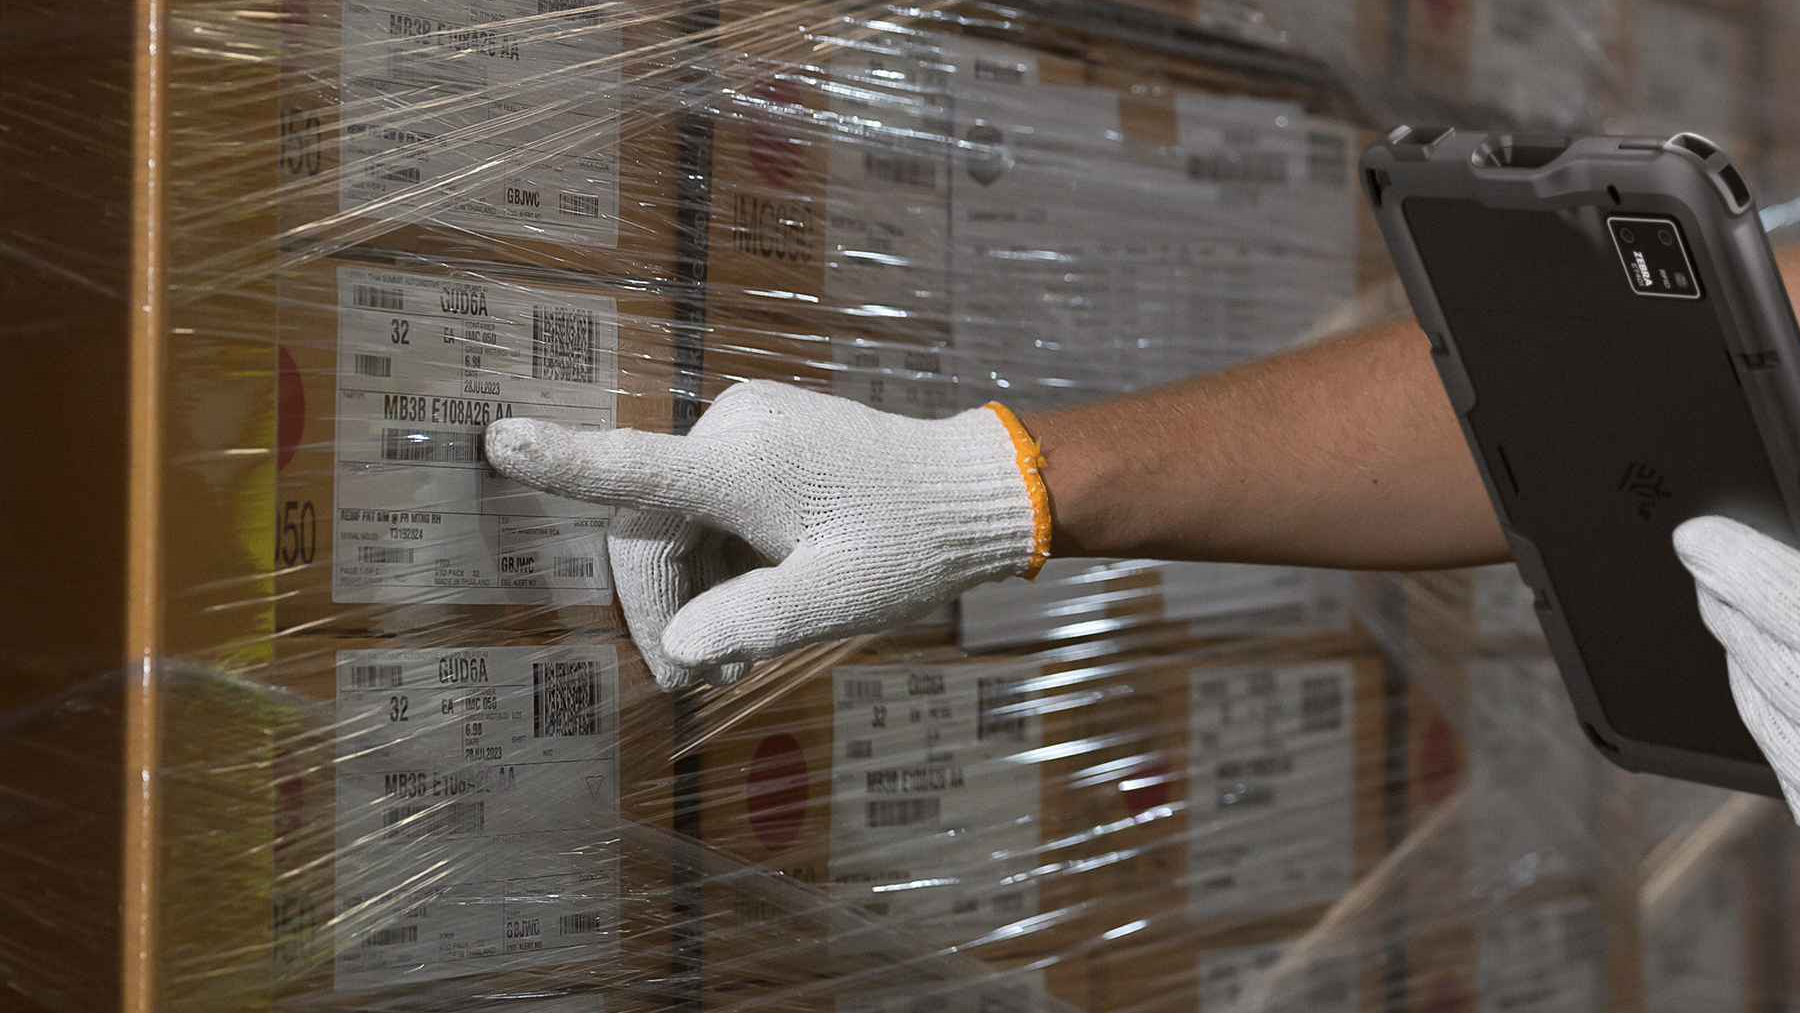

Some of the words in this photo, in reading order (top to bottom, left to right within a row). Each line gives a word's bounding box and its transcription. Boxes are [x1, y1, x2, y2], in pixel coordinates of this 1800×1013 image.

[507, 187, 540, 208] GBJWC
[1633, 250, 1653, 286] ZEBRA
[1660, 269, 1671, 288] RFID
[440, 287, 488, 317] GUD6A
[391, 319, 410, 345] 32
[444, 328, 455, 344] EA
[465, 355, 481, 369] 6.98
[384, 394, 426, 422] MB3B
[432, 398, 490, 426] E108A26
[400, 513, 409, 523] FR
[411, 514, 430, 524] MTNG
[431, 514, 441, 524] RH
[449, 569, 465, 577] PACK
[472, 569, 480, 577] 32
[501, 556, 534, 574] GBJWC
[461, 578, 491, 586] THAILAND
[439, 658, 488, 683] GUD6A
[390, 696, 409, 721] 32
[442, 699, 453, 715] EA
[465, 698, 481, 711] IMC
[483, 696, 497, 710] 050
[465, 723, 482, 736] 6.98
[519, 942, 534, 950] ALERT
